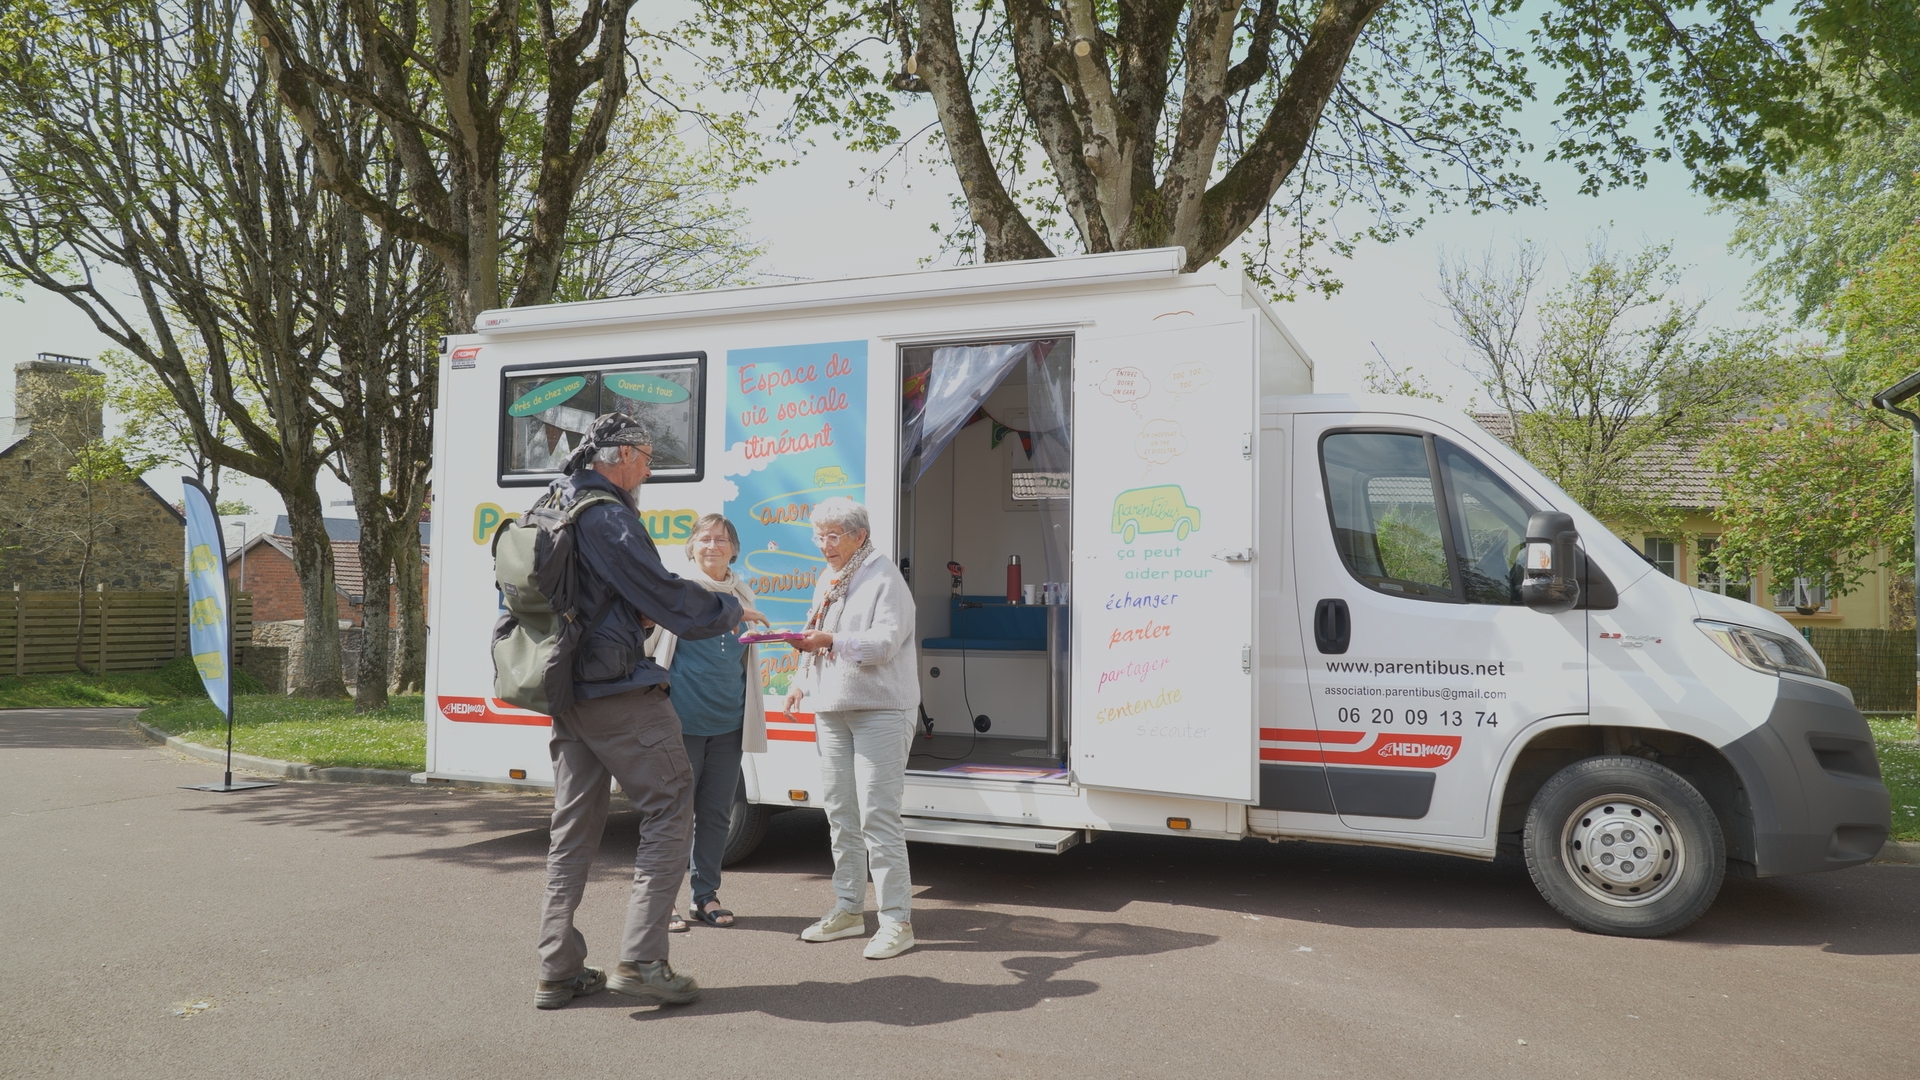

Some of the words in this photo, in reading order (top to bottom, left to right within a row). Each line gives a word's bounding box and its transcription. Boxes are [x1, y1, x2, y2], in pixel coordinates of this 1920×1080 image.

[617, 379, 645, 392] Ouvert
[647, 383, 653, 393] à
[656, 386, 673, 397] tous
[738, 363, 818, 396] Espace
[825, 352, 852, 378] de
[514, 400, 531, 413] Près
[532, 396, 542, 405] de
[544, 388, 562, 400] chez
[563, 381, 580, 392] vous
[741, 404, 769, 427] vie
[776, 386, 849, 421] sociale
[743, 422, 834, 460] itinérant
[1117, 549, 1135, 560] ça
[1144, 546, 1182, 561] peut
[748, 566, 828, 595] convivi
[1125, 567, 1169, 580] aider
[1174, 568, 1213, 582] pour
[1105, 591, 1178, 610] échanger
[1108, 620, 1172, 649] parler
[759, 649, 799, 688] grat
[1097, 657, 1170, 693] partager
[1326, 660, 1506, 677] www.parentibus.net
[1096, 687, 1182, 725] s'entendre
[1324, 686, 1507, 700] association.parentibus@gmail.com
[1136, 719, 1210, 739] s'écouter
[1338, 707, 1361, 723] 06
[1371, 708, 1394, 724] 20
[1405, 709, 1428, 726] 09
[1439, 710, 1463, 727] 13
[1475, 711, 1498, 728] 74
